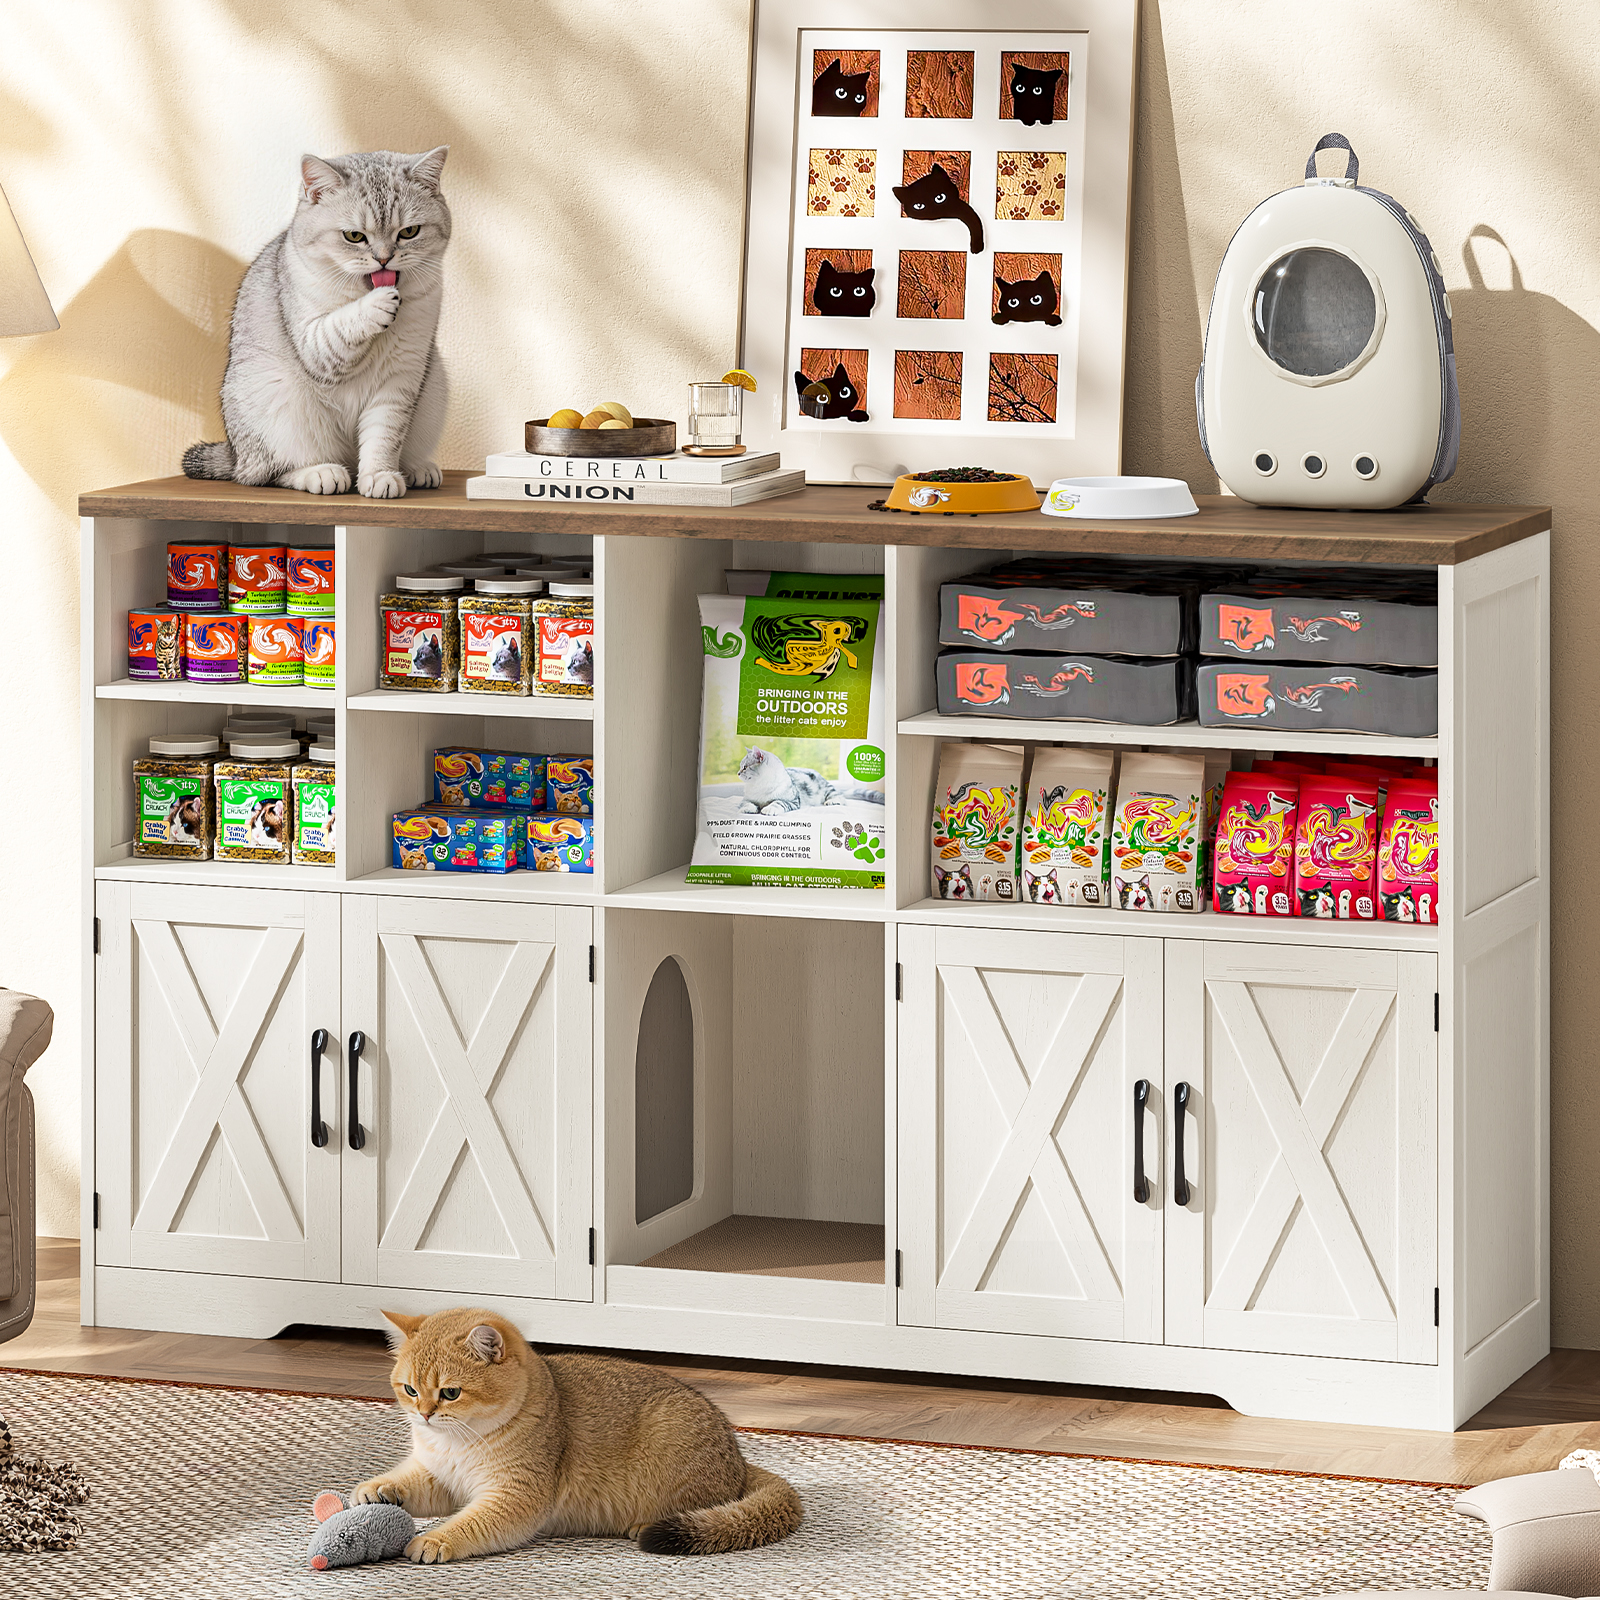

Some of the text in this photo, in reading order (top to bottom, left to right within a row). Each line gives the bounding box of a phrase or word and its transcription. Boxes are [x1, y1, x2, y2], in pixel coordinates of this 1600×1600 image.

[540, 460, 668, 480] CEREAL
[524, 483, 634, 500] UNION
[758, 688, 849, 700] BRINGING IN THE
[756, 699, 848, 715] OUTDOORS
[756, 714, 847, 728] the litter cats enjoy
[853, 752, 882, 762] 100%
[144, 821, 168, 831] Crabby
[147, 827, 165, 835] Tuna
[226, 825, 249, 835] Crabby
[229, 831, 245, 839] Tuna
[303, 829, 326, 839] Crabby
[306, 834, 322, 842] Tuna
[436, 846, 448, 855] 32
[570, 848, 582, 857] 32
[751, 873, 782, 882] BRINGING
[804, 876, 842, 884] OUTDOORS
[997, 881, 1012, 891] 3.15
[1083, 886, 1098, 896] 3.15
[1177, 892, 1192, 903] 3.15
[1274, 895, 1287, 905] 3.15
[1358, 899, 1371, 909] 3.15
